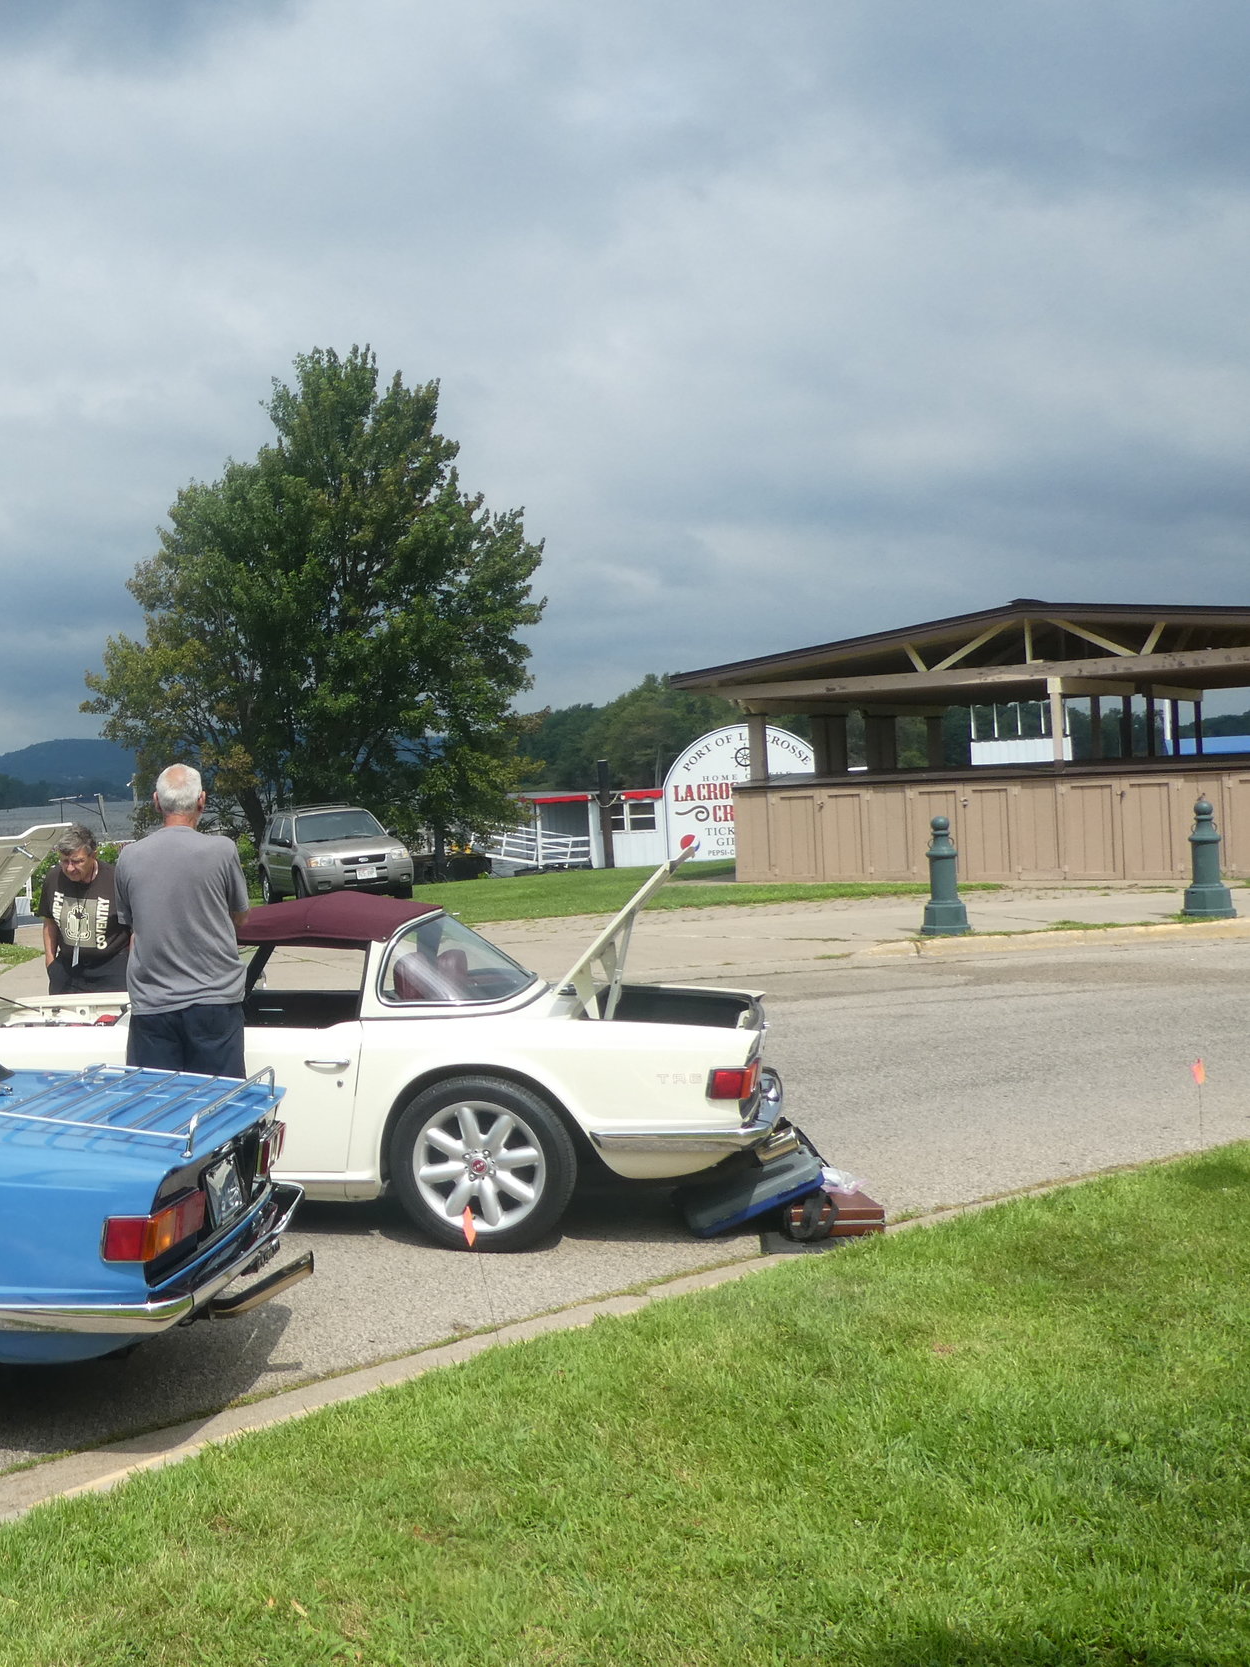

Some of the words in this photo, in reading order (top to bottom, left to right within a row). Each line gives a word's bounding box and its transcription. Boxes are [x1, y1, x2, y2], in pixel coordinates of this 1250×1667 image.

[683, 743, 712, 772] PORT
[715, 734, 733, 747] OF
[96, 896, 110, 950] COVENTRY
